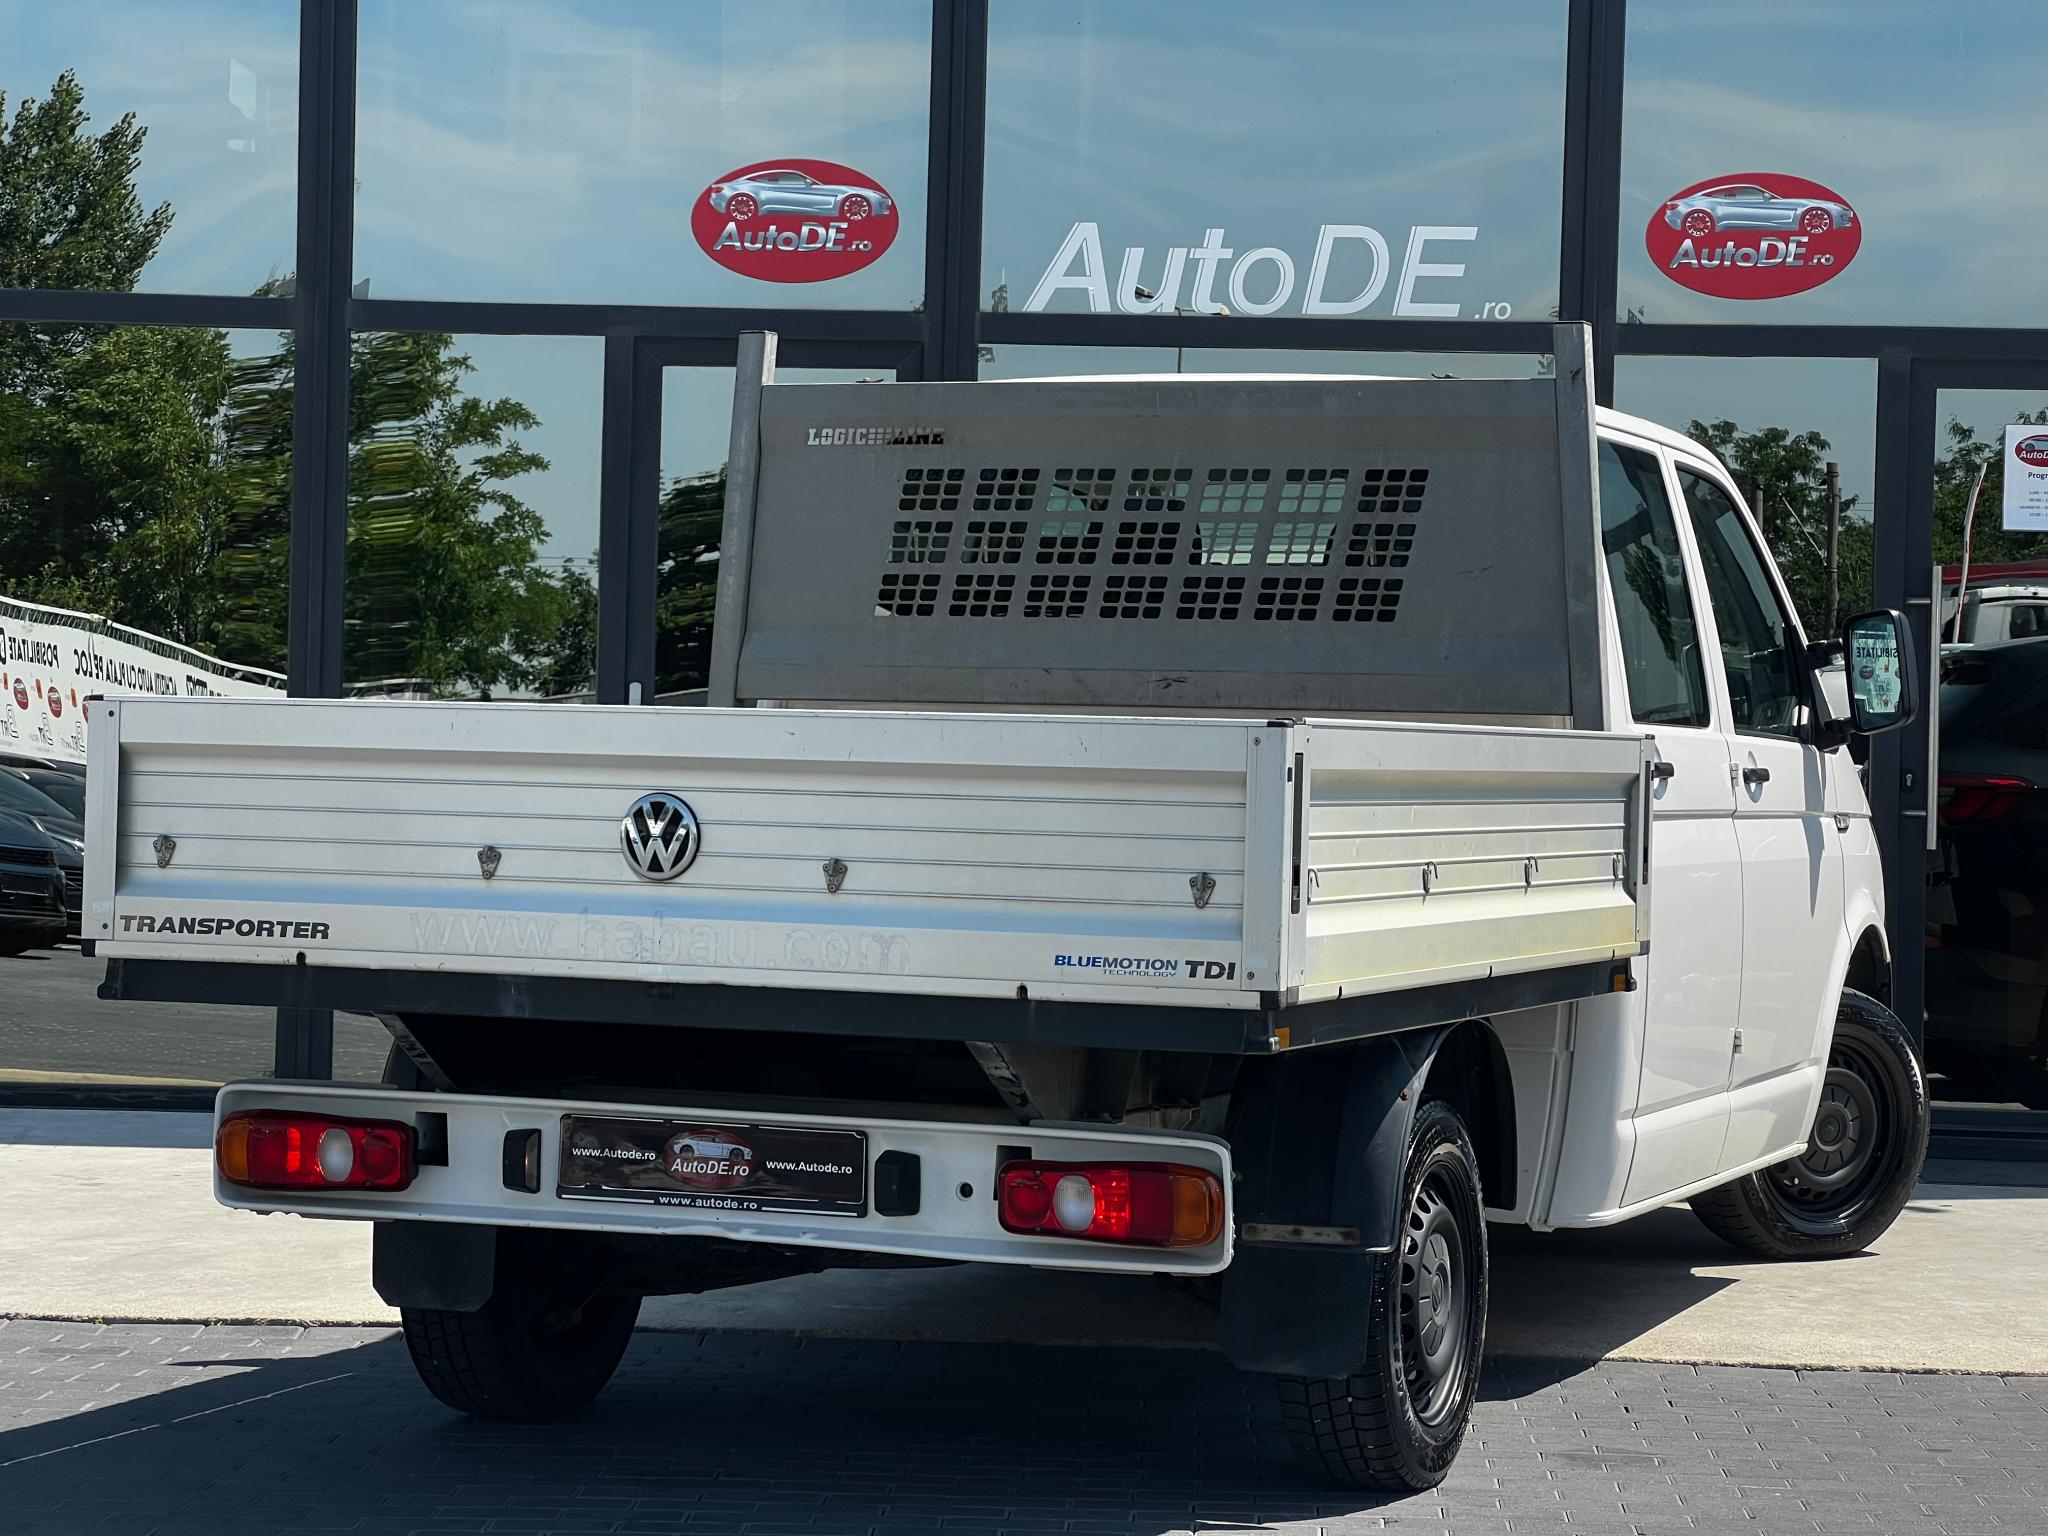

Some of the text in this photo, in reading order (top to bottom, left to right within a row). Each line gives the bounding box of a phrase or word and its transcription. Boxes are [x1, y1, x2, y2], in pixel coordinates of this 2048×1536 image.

[120, 914, 330, 940] TRANSPORTER
[1054, 954, 1236, 981] BLUEMOTION TDI
[1102, 968, 1177, 978] TECHNOLOGY
[572, 1145, 656, 1162] www.Autode.ro
[670, 1158, 750, 1177] AutoDE.ro
[766, 1158, 853, 1175] www.Autode.ro
[659, 1195, 758, 1211] www.autode.ro
